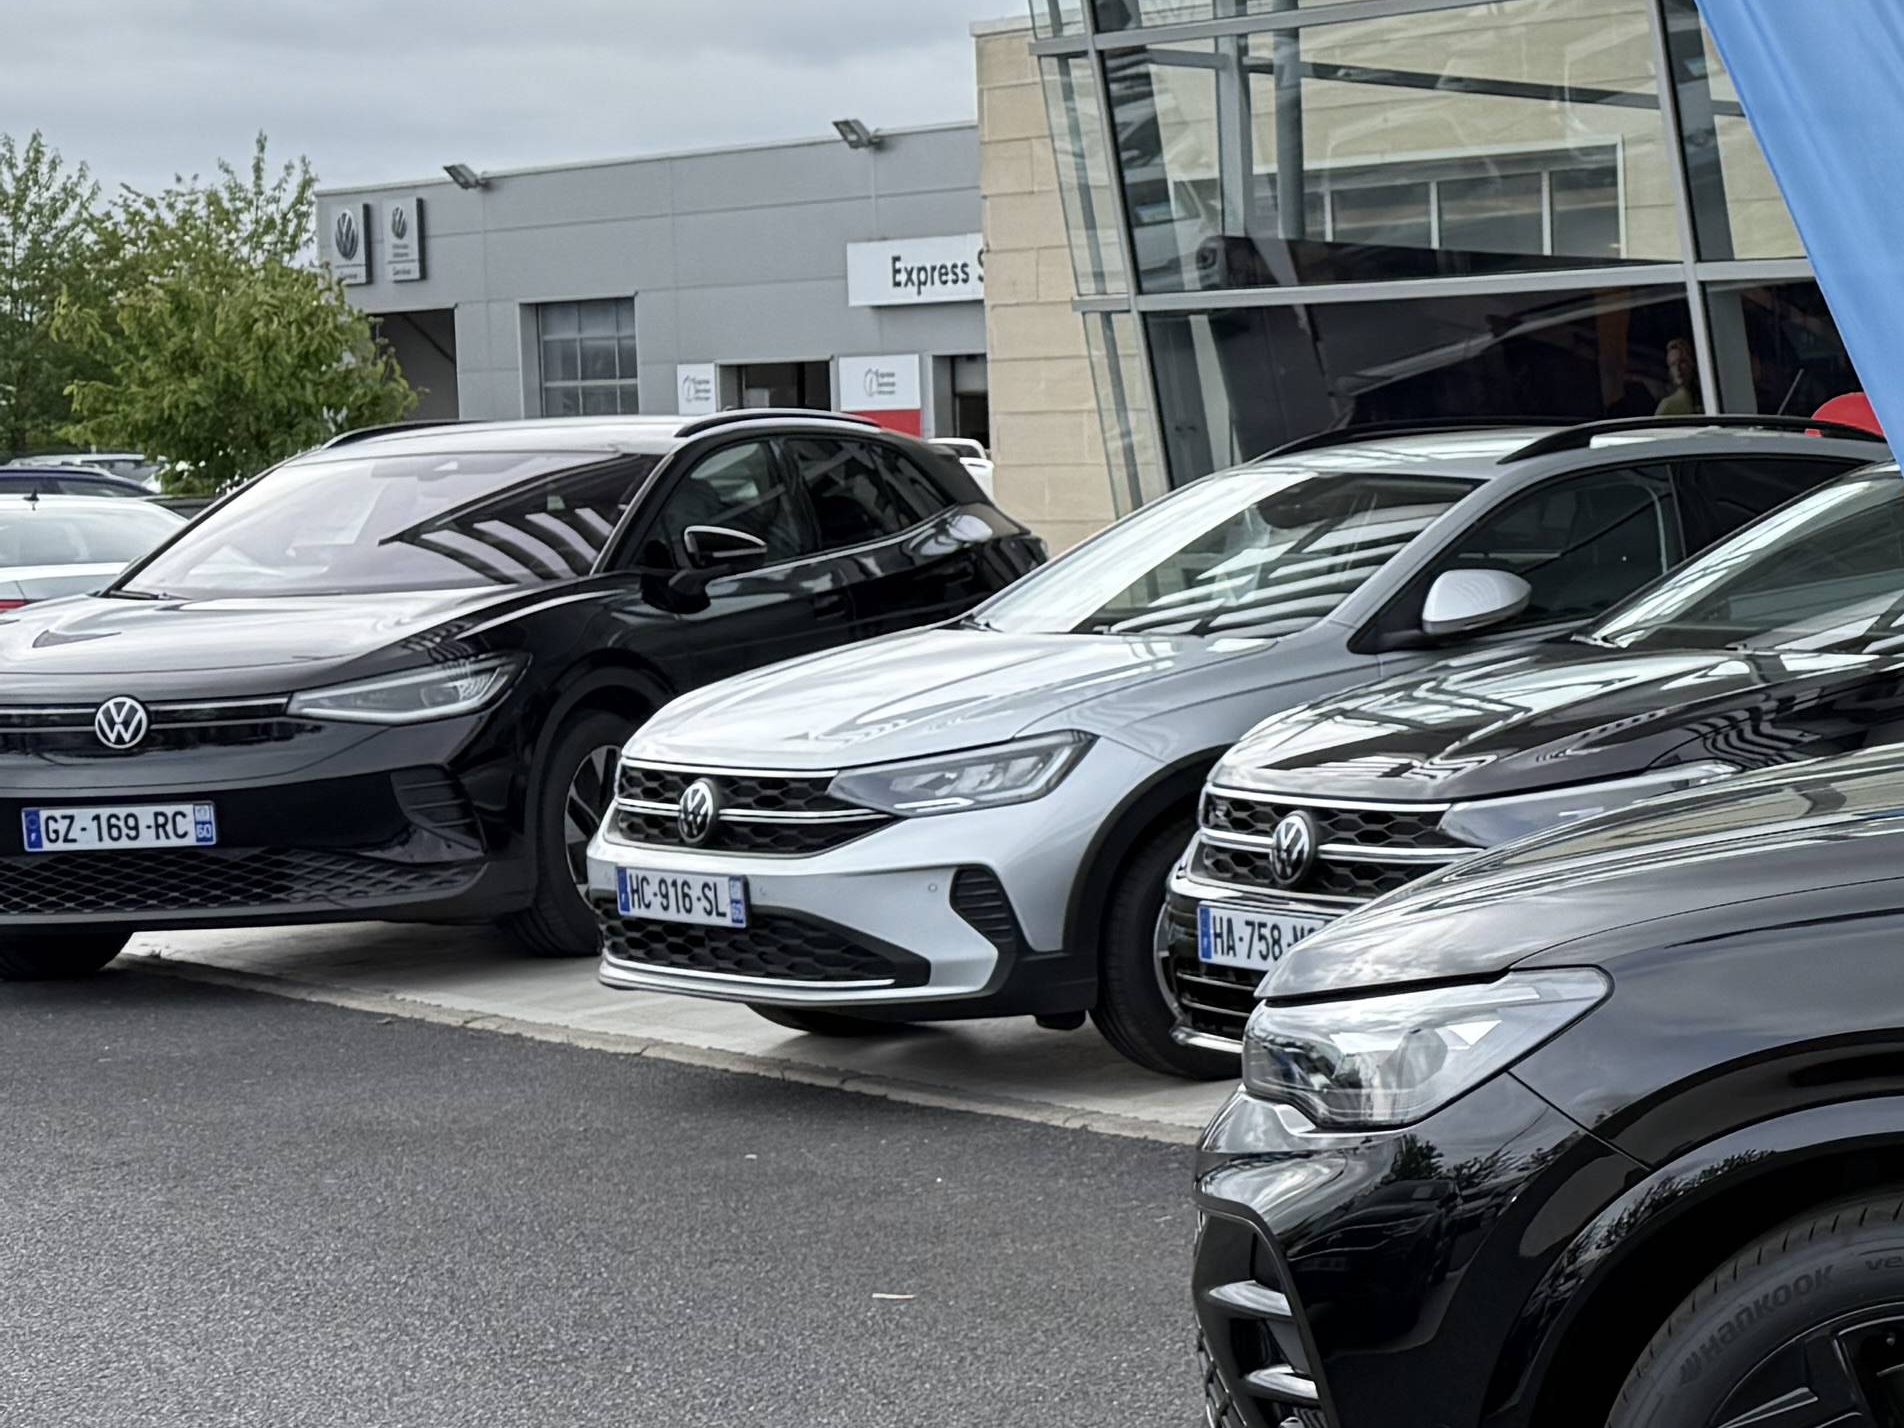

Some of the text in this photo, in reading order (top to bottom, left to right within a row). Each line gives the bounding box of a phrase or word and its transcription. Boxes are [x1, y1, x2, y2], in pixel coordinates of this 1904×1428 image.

[891, 255, 970, 296] Express
[44, 810, 190, 844] GZ-169-RC
[628, 872, 728, 919] HC-916-SL
